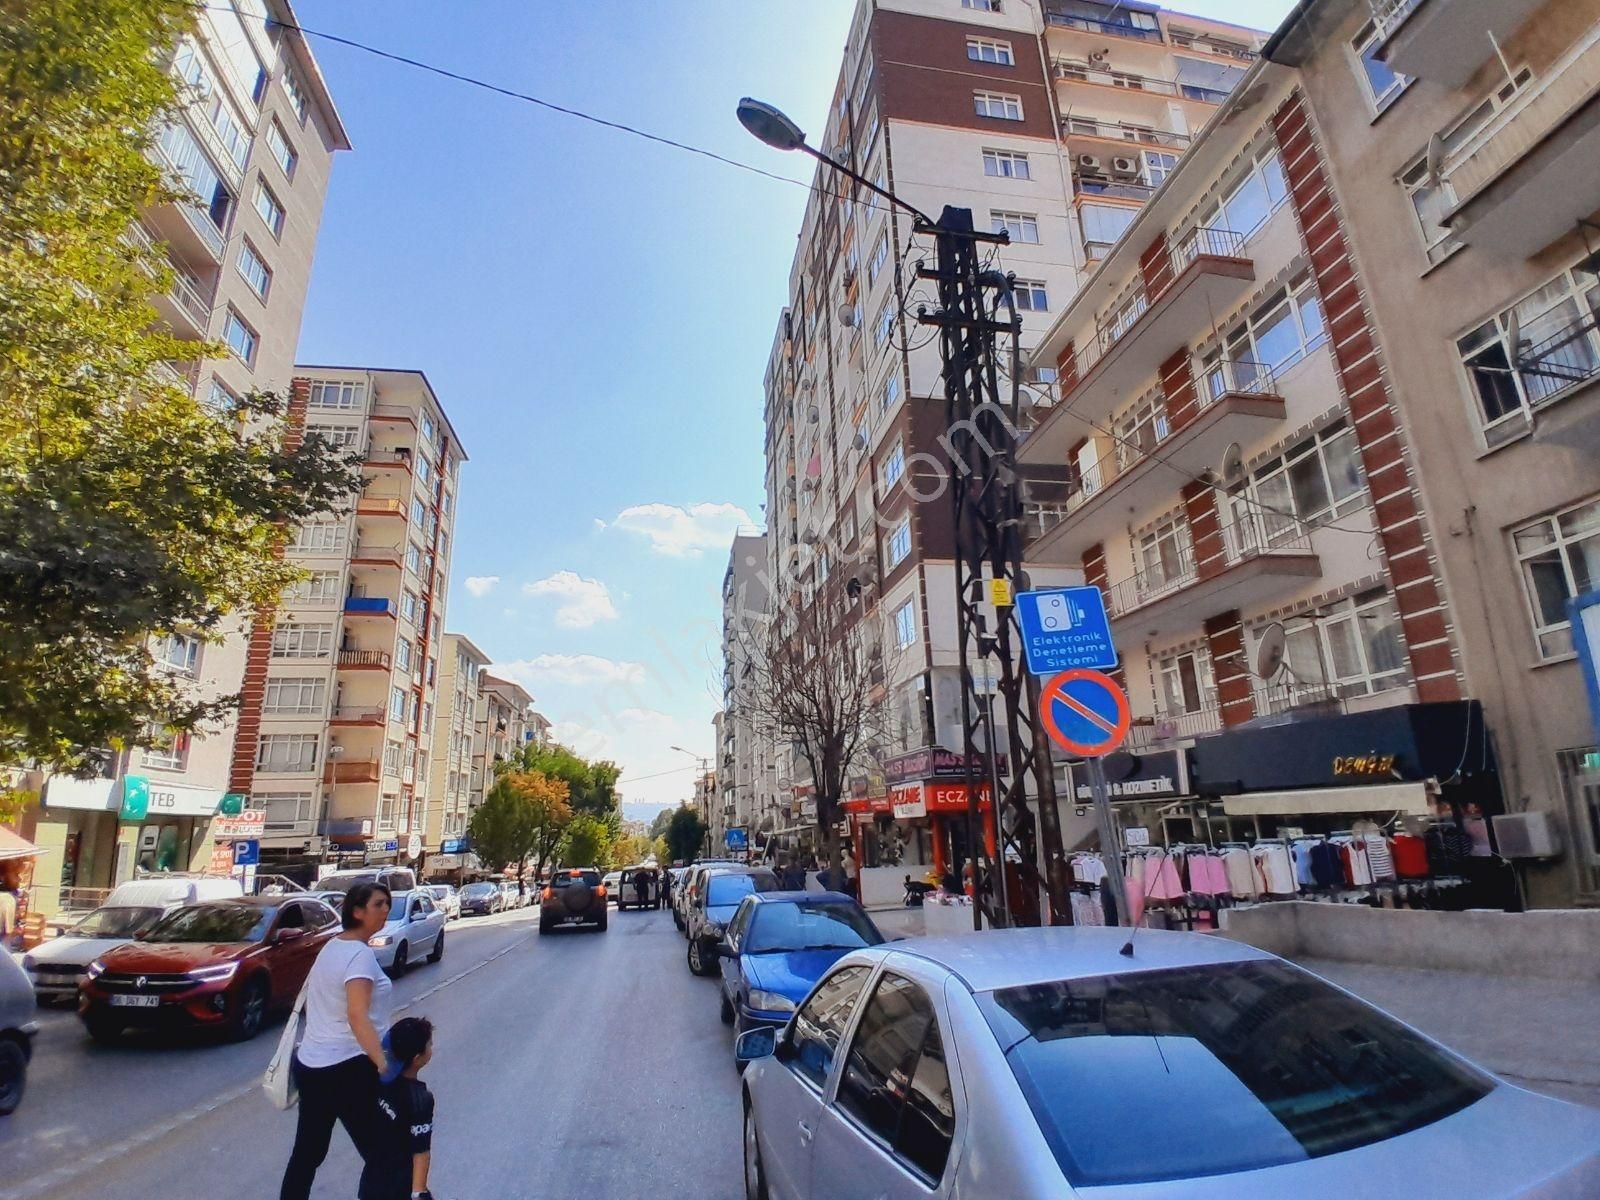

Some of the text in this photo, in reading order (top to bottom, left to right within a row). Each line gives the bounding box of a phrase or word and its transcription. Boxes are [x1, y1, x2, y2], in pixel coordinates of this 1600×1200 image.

[1033, 632, 1102, 646] Elektronik
[1033, 643, 1107, 657] Denetleme
[1047, 655, 1099, 667] Sistemi
[150, 792, 175, 807] TEB
[937, 790, 990, 803] ECZN
[235, 841, 250, 864] P
